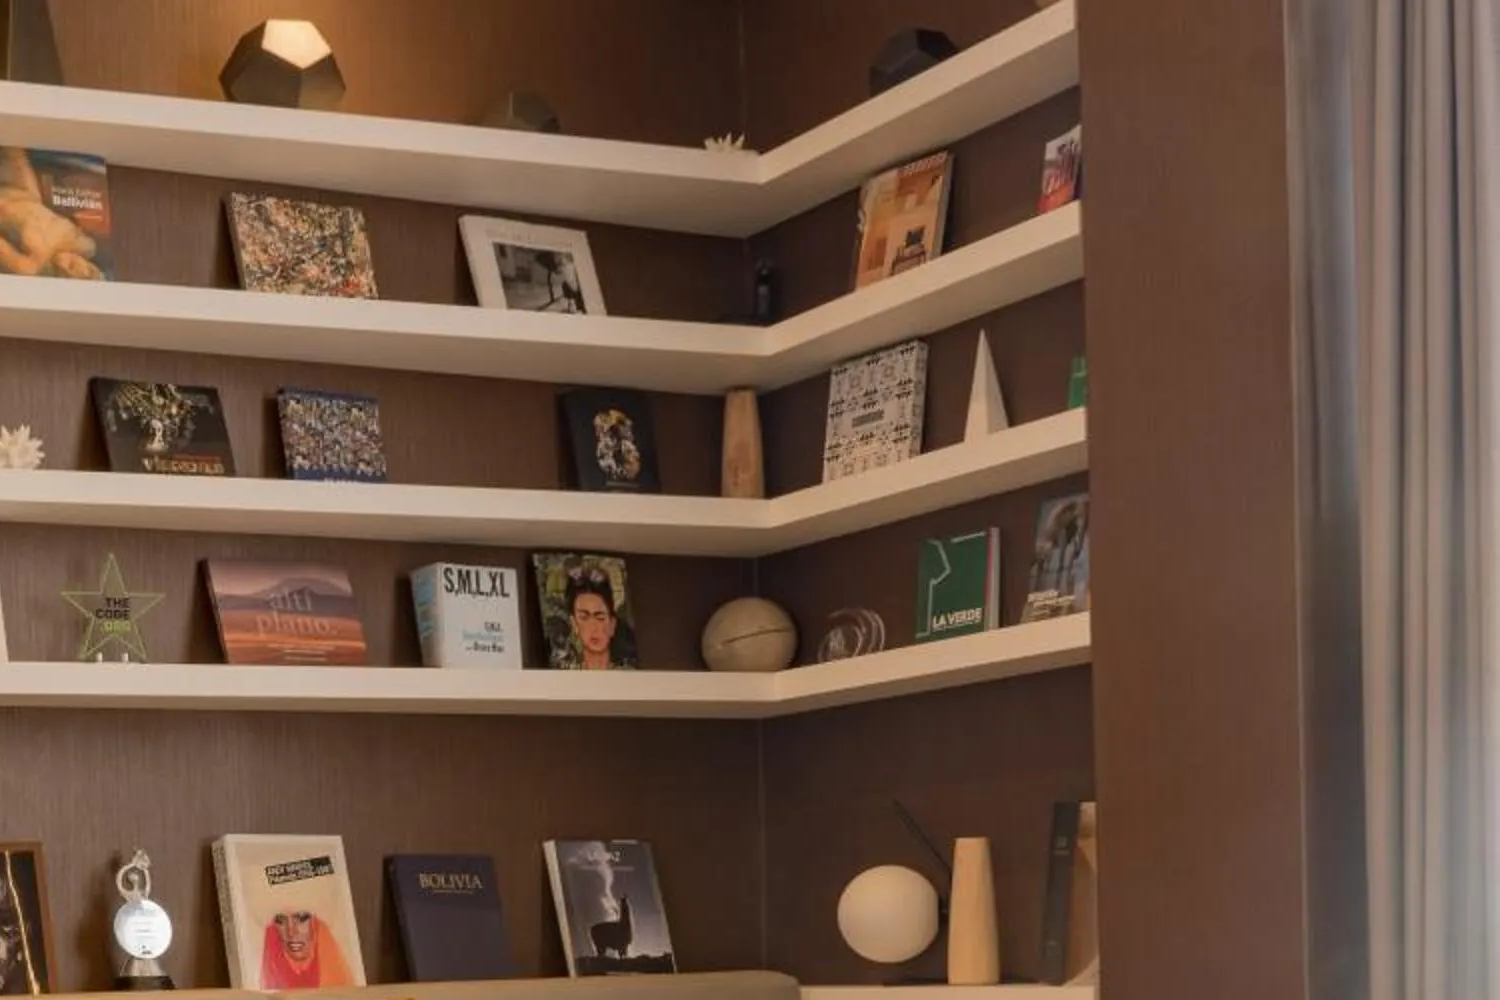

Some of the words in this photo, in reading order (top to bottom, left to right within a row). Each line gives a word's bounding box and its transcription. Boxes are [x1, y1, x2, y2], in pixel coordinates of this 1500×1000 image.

[106, 597, 130, 609] THE
[95, 608, 131, 621] CODE
[419, 873, 484, 889] BOLIVIA
